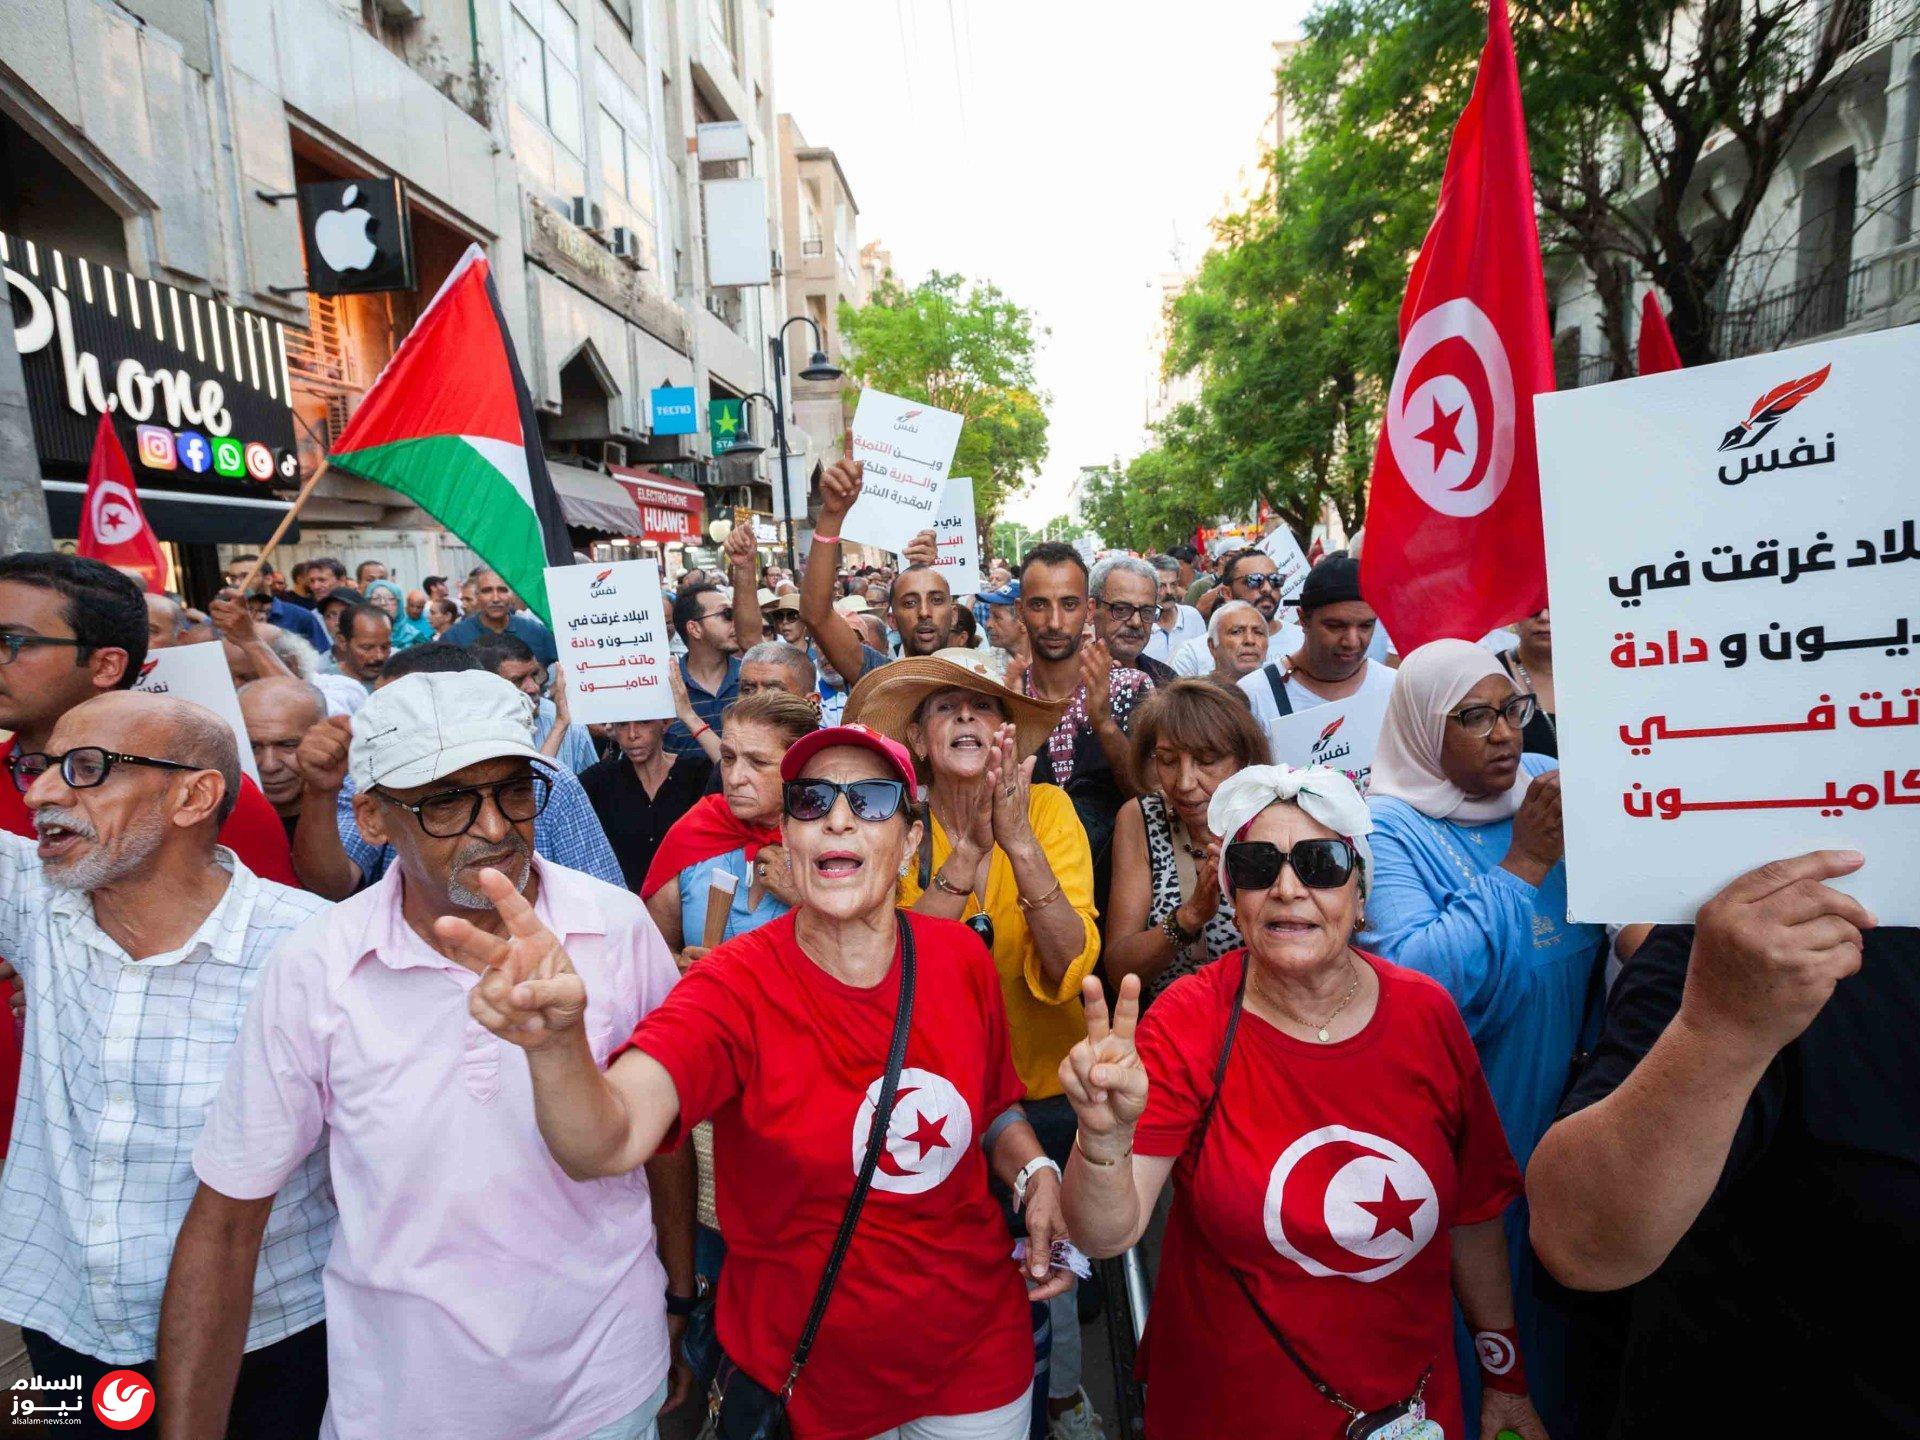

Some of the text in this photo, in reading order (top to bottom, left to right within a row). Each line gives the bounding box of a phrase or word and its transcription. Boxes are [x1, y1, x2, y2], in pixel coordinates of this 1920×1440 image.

[656, 405, 691, 416] TECNO
[893, 422, 918, 433] نفس
[715, 440, 734, 448] STA
[854, 434, 892, 454] التنمية
[1718, 432, 1835, 485] نفس
[637, 487, 688, 507] ELECTRO PHONE
[891, 490, 932, 510] المقدرة
[644, 506, 689, 534] HUAWEI
[1609, 520, 1920, 608] لاد غرقت في
[590, 585, 617, 598] نفس
[568, 610, 649, 630] البلاد غرقت في
[571, 632, 653, 648] الديون و دادة
[1611, 618, 1920, 668] يون و دادة
[576, 654, 655, 673] ماتت في
[580, 675, 658, 692] الكاميون
[1620, 688, 1920, 755] تت في
